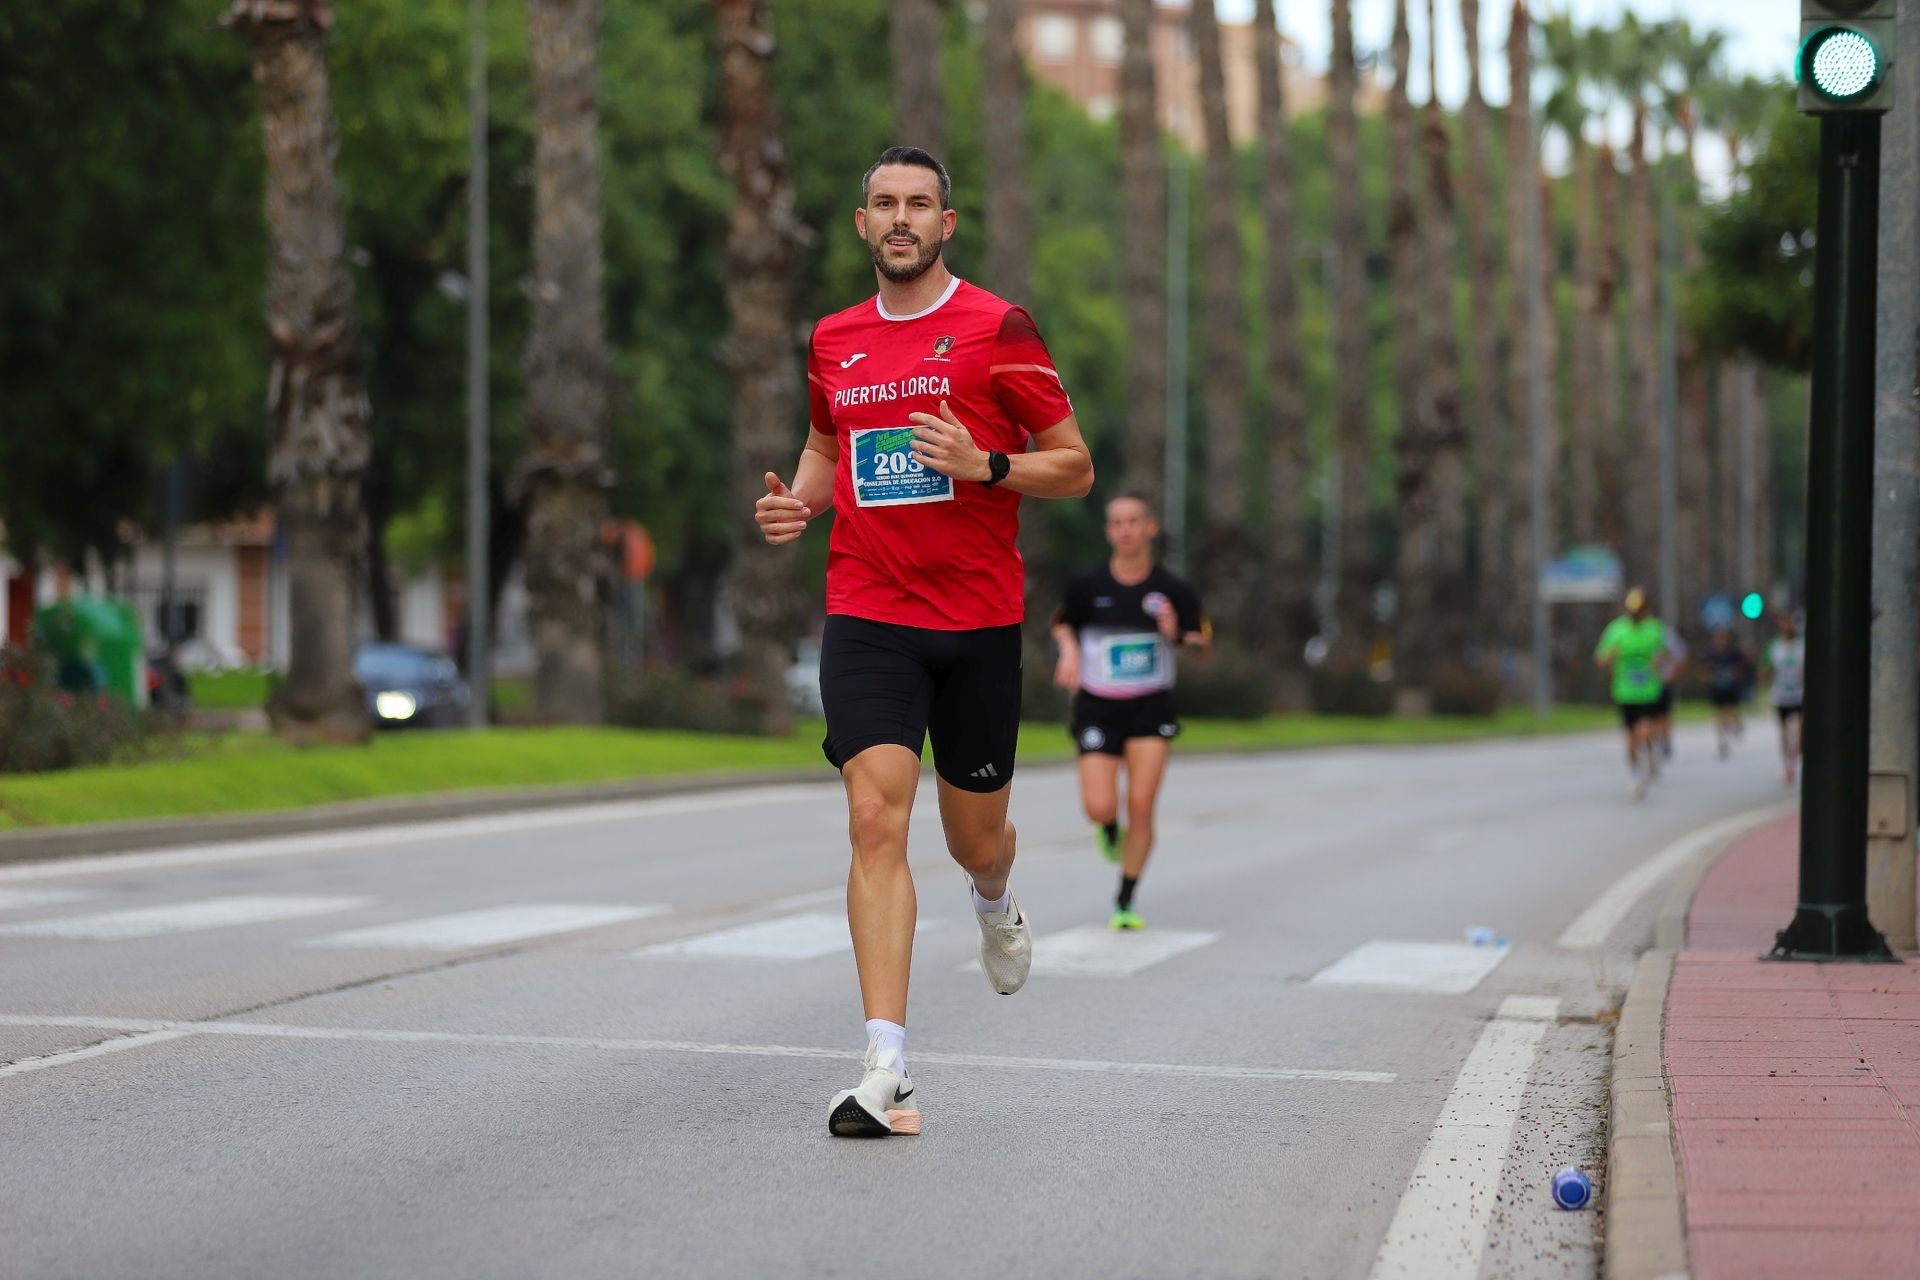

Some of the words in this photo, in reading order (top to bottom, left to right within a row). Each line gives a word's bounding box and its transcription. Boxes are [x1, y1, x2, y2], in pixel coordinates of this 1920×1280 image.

[834, 382, 897, 408] PUERTAS
[901, 376, 951, 398] LORCA
[874, 451, 924, 475] 203
